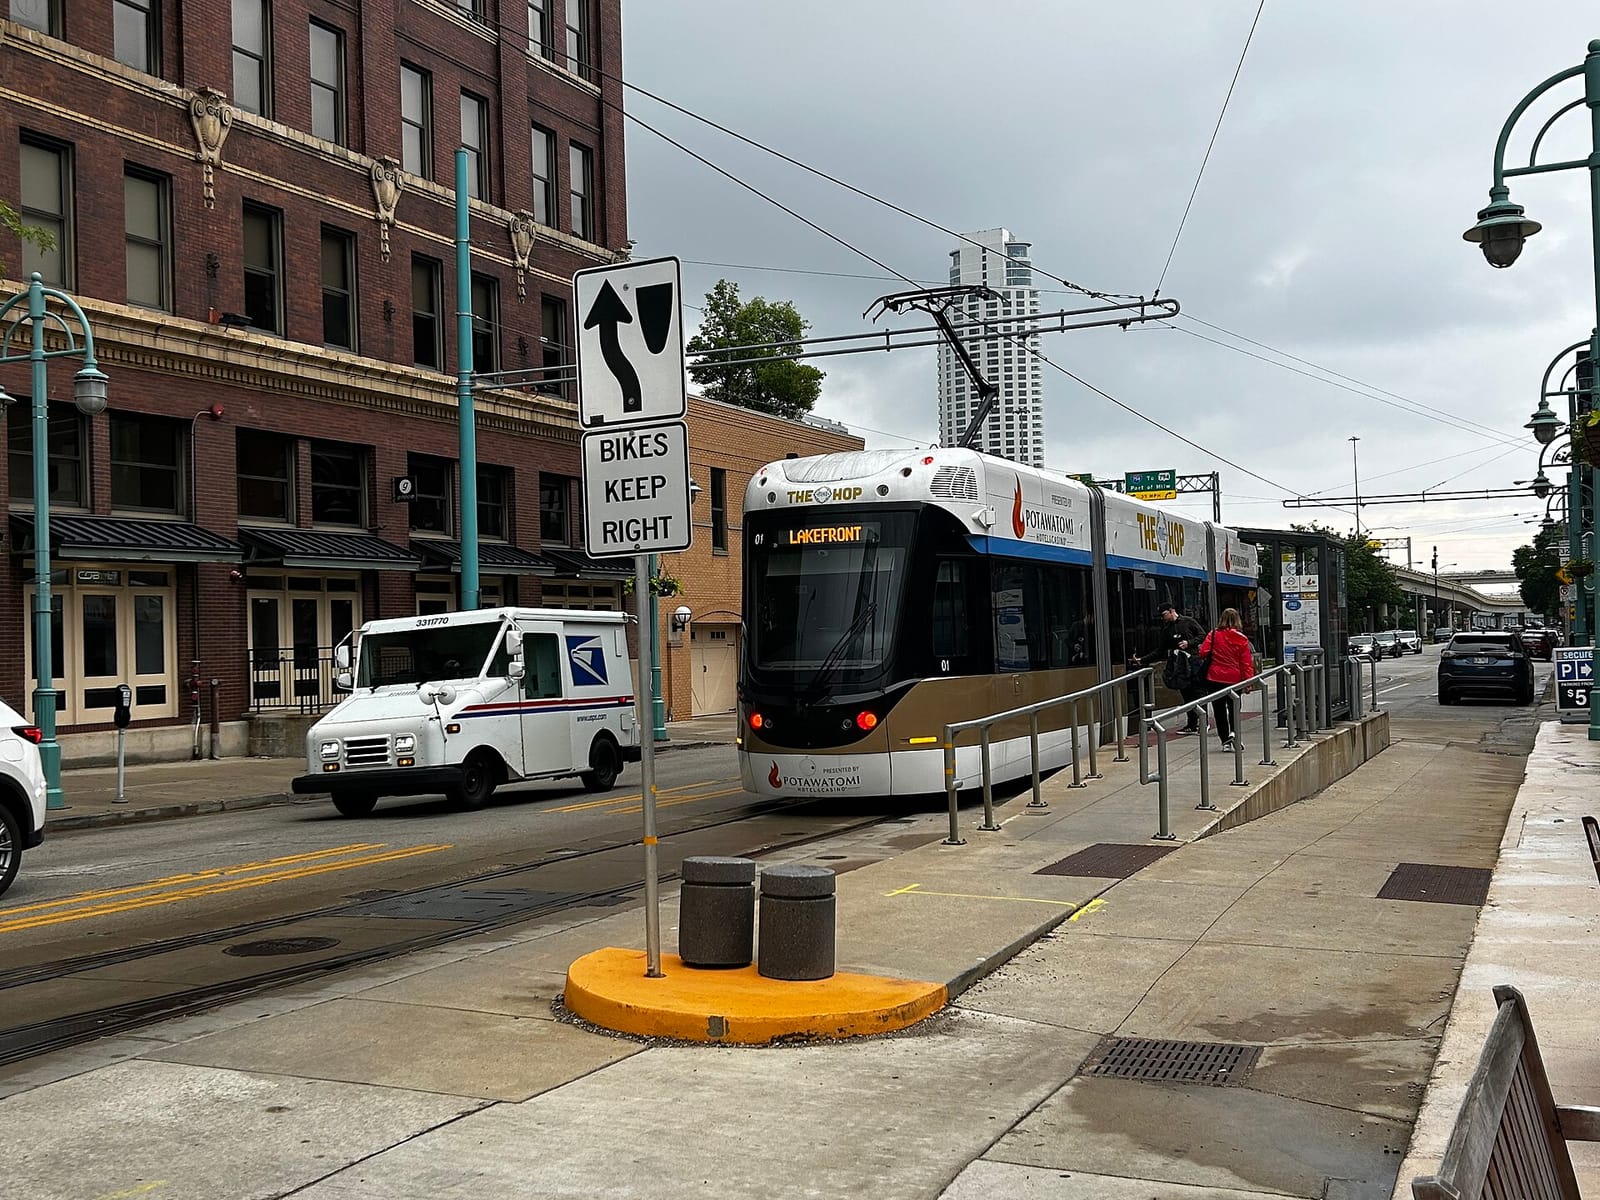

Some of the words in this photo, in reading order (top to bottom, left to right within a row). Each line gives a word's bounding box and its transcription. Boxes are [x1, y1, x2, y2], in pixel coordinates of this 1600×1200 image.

[600, 433, 668, 462] BIKES
[605, 475, 667, 503] KEEP
[787, 490, 814, 504] THE
[832, 487, 863, 501] HOP
[602, 515, 673, 544] RIGHT
[1025, 509, 1074, 535] POTAWATOMI
[754, 534, 764, 545] 01
[789, 526, 862, 545] LAKEFRONT
[1137, 512, 1158, 552] THE
[1168, 521, 1185, 557] HOP
[415, 617, 449, 627] 3311770
[941, 659, 950, 672] 01
[1561, 664, 1572, 678] P
[1567, 689, 1587, 706] $5
[783, 775, 860, 787] POTAWATOMI
